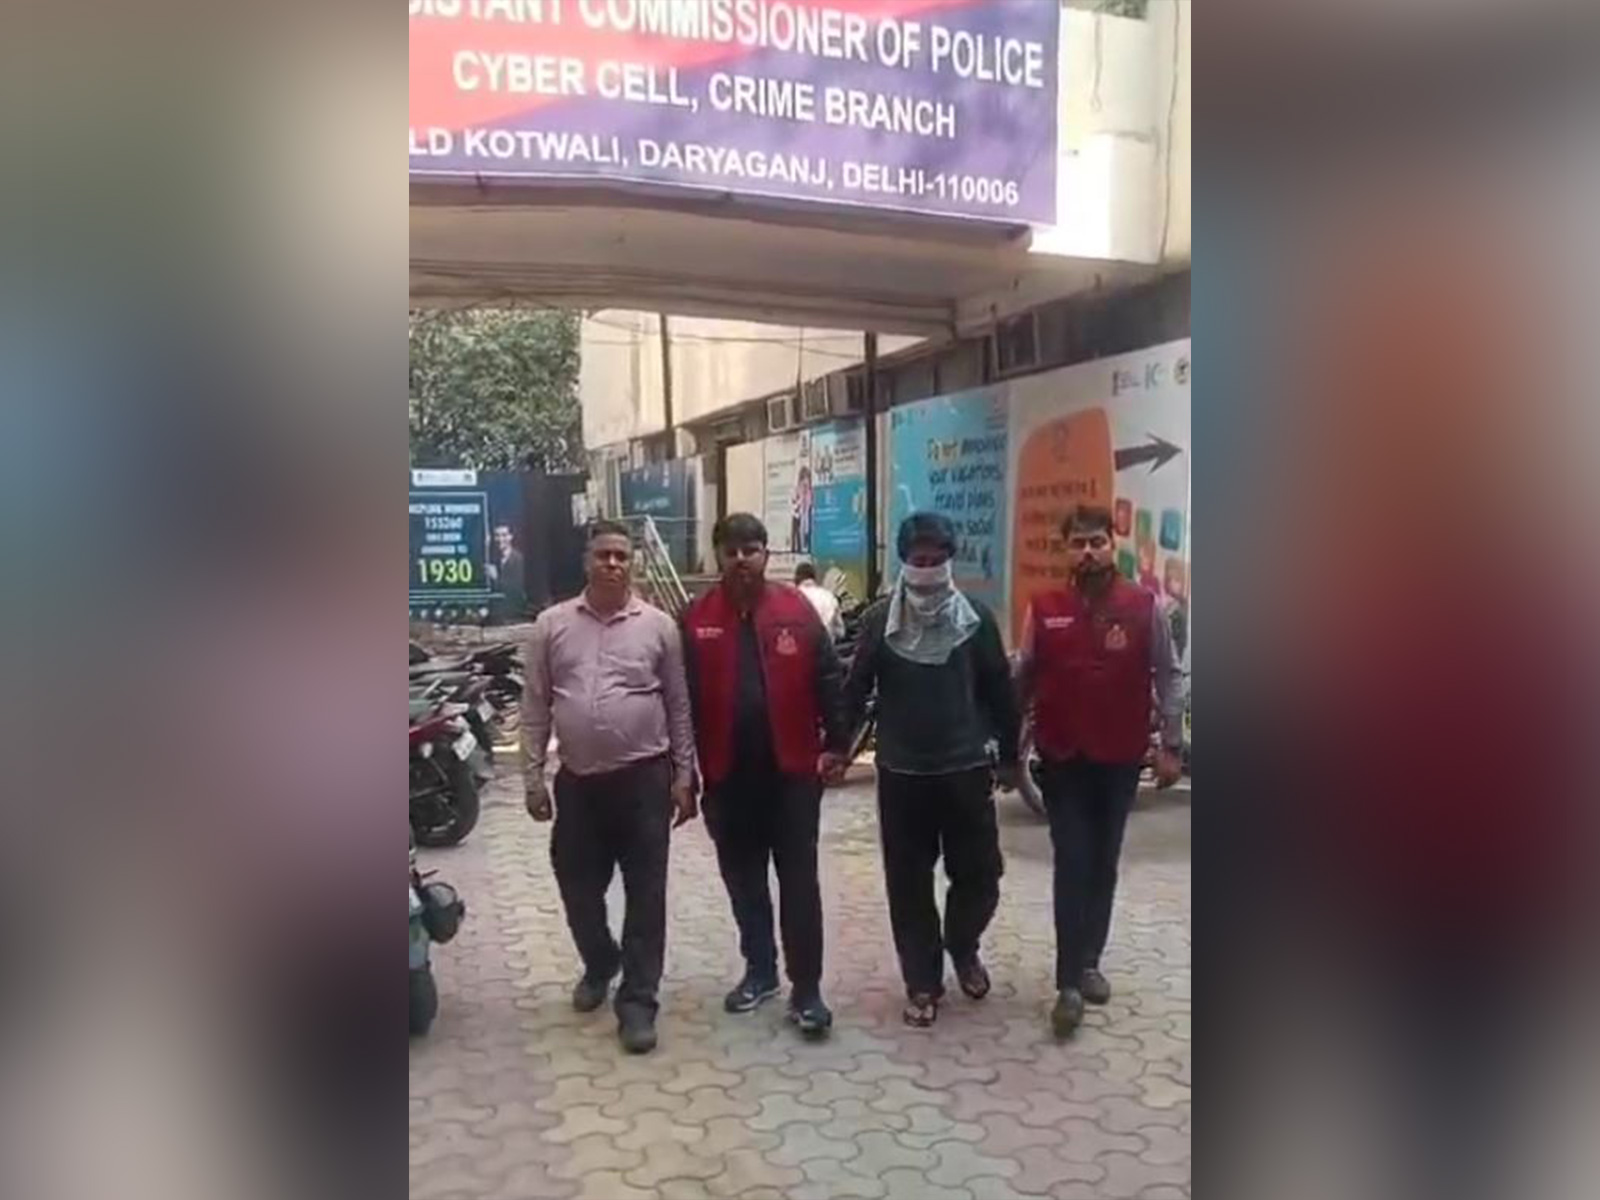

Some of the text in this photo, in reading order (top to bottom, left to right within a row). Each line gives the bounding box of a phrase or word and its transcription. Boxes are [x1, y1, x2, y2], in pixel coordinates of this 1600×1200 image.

[580, 0, 868, 61] COMMISSIONER
[877, 17, 921, 68] OF
[931, 26, 1044, 88] POLICE
[453, 50, 955, 138] CYBER CELL, CRIME BRANCH
[464, 129, 628, 167] KOTWALI,
[639, 139, 833, 189] DARYAGANJ,
[843, 162, 1018, 205] DELHI-110006
[418, 558, 472, 583] 1930
